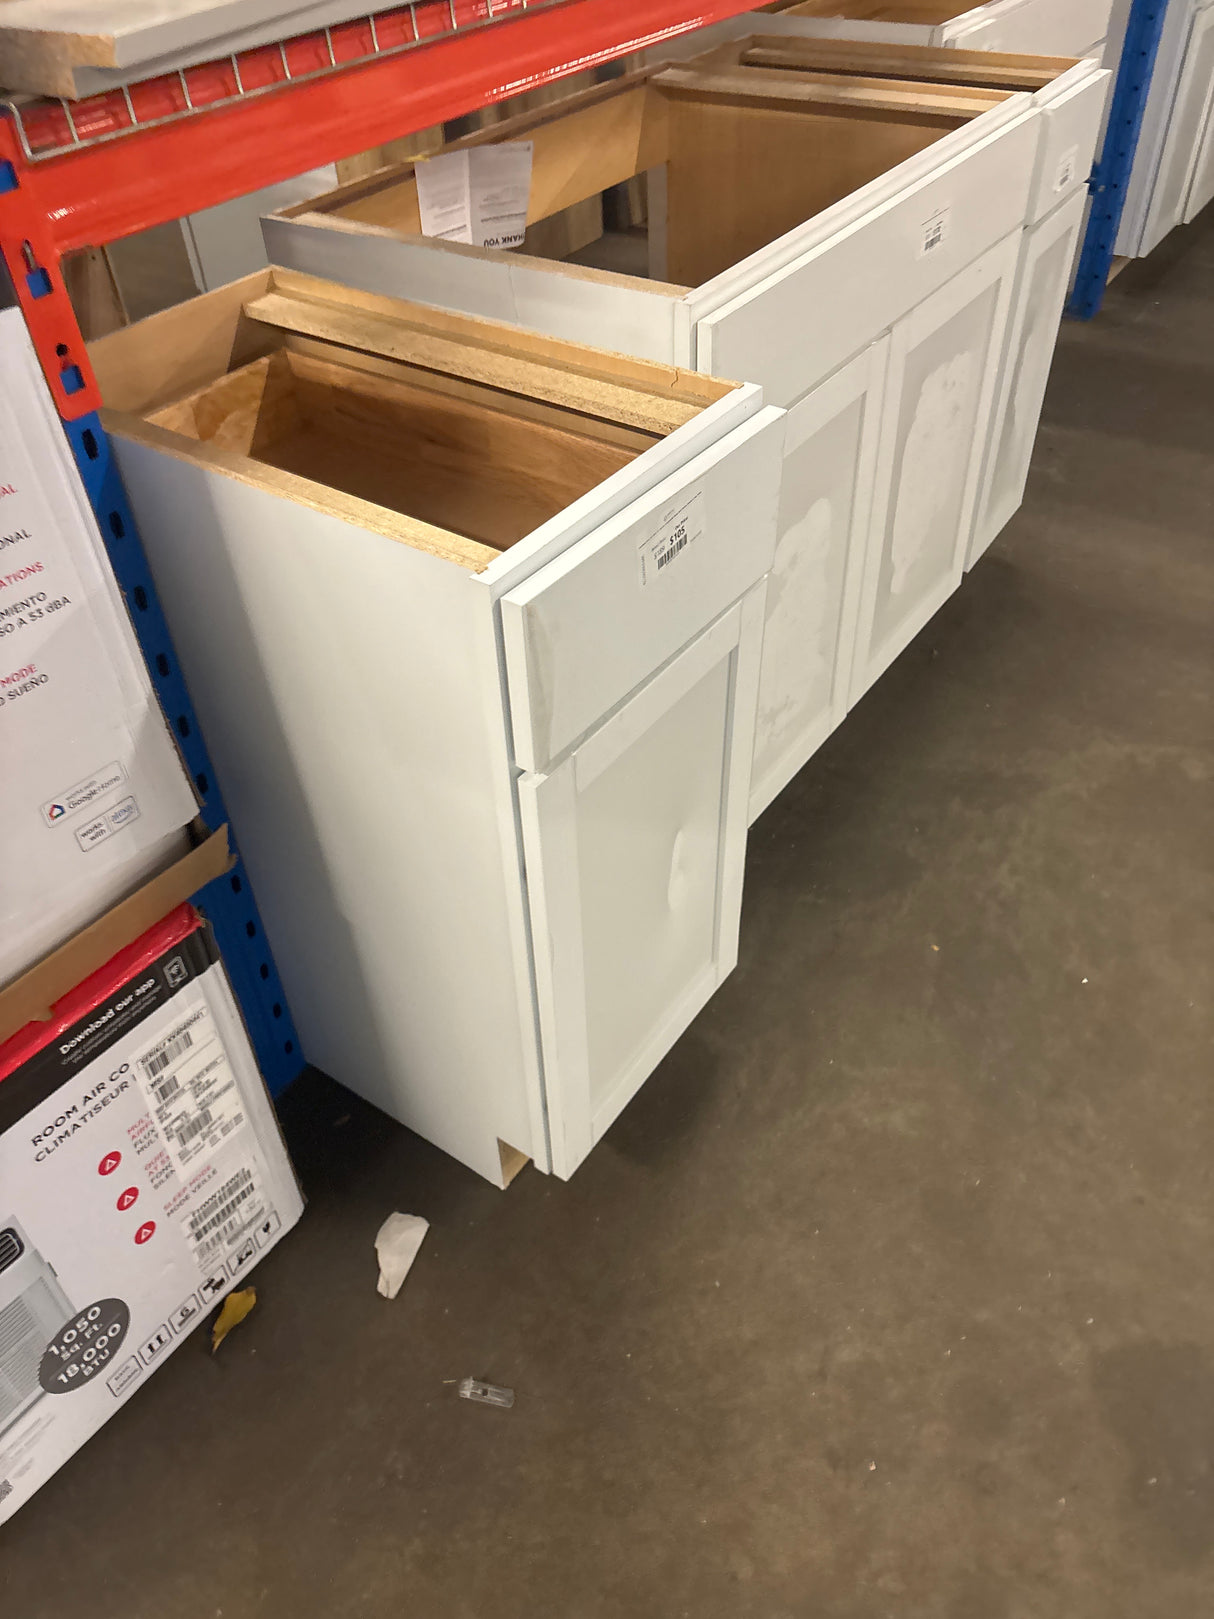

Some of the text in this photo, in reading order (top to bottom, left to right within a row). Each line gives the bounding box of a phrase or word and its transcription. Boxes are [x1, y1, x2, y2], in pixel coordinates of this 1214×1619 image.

[483, 239, 500, 248] YOU
[17, 617, 28, 629] A
[0, 663, 38, 688] MODE
[59, 978, 155, 1054] Download our app
[31, 1104, 79, 1147] ROOM
[82, 1081, 107, 1107] AIR
[109, 1063, 130, 1082] CO
[34, 1081, 130, 1162] CLIMATISEUR
[166, 1194, 191, 1218] MODE
[48, 1306, 101, 1355] 1,050
[57, 1323, 121, 1384] 18,000
[82, 1348, 110, 1376] BTU
